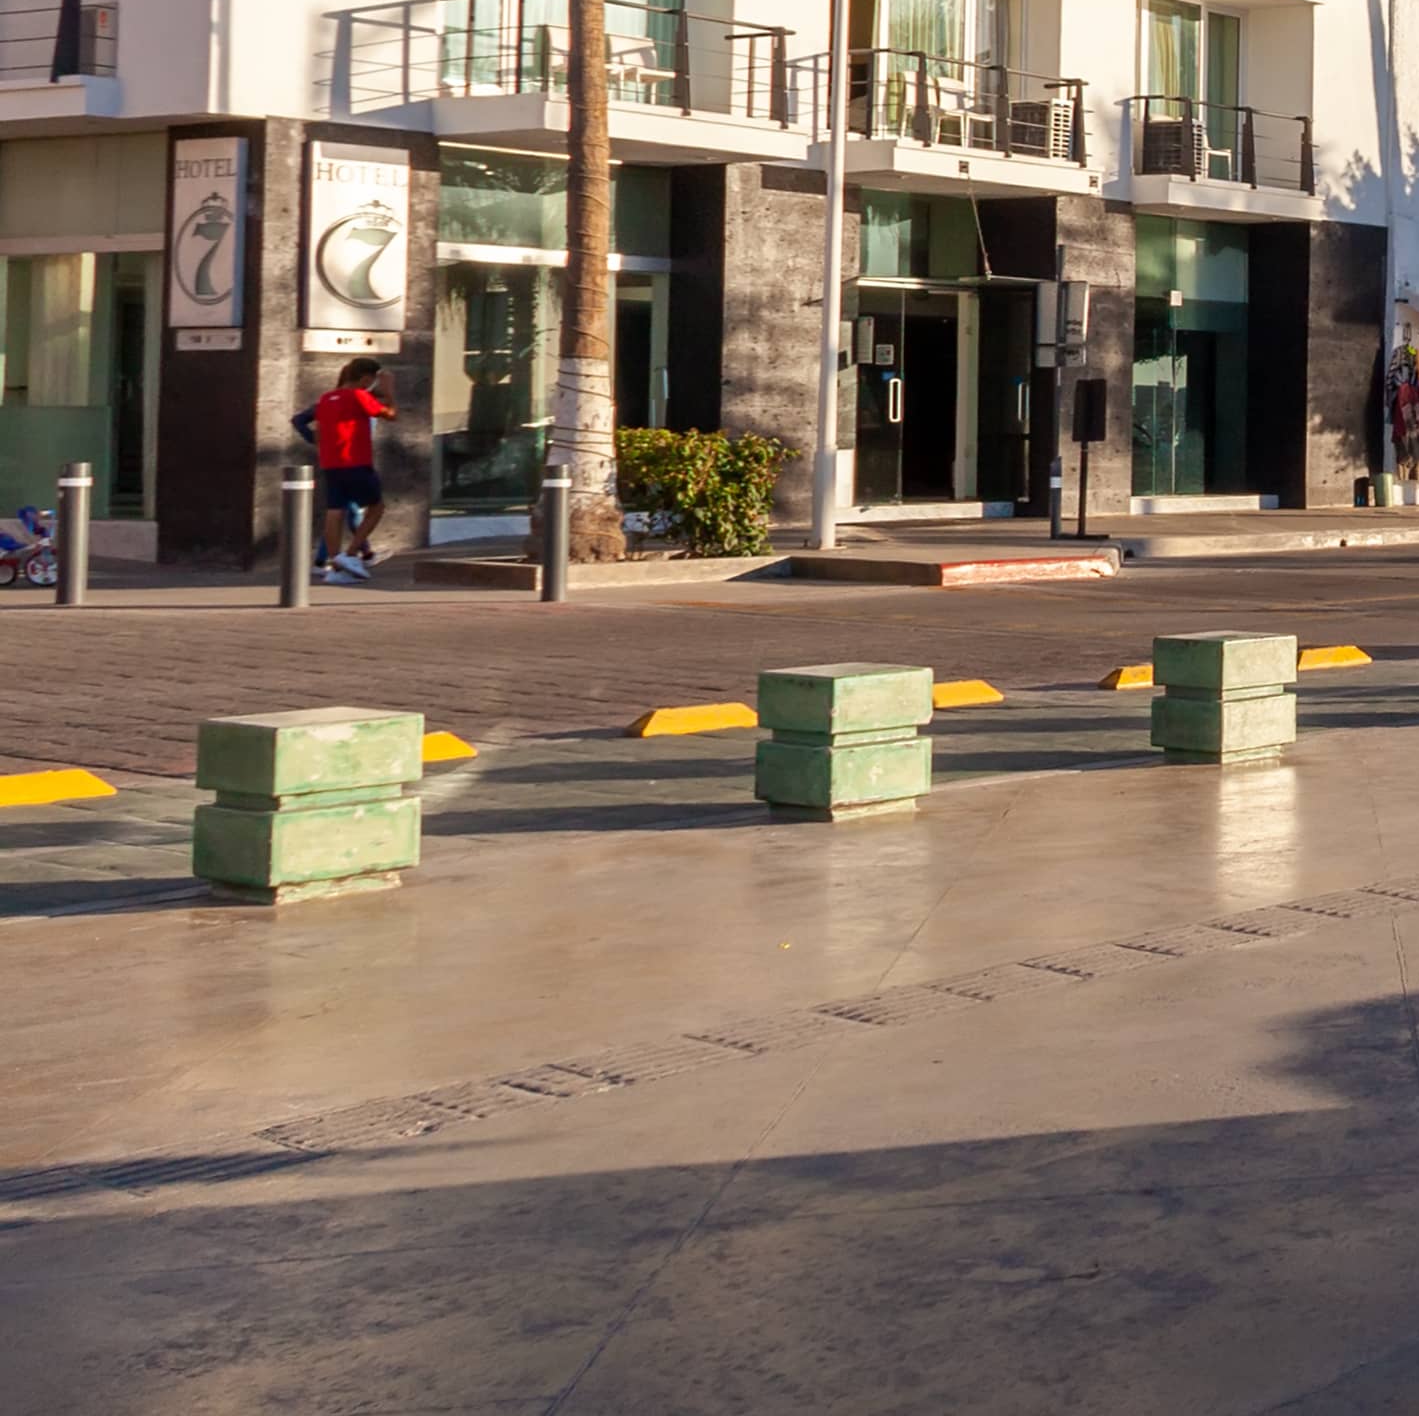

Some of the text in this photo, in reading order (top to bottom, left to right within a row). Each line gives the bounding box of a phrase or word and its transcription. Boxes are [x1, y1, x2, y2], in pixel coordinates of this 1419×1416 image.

[175, 158, 236, 179] HOTEL
[316, 162, 408, 187] HOTEL
[192, 222, 231, 296] 7
[345, 227, 398, 301] 7
